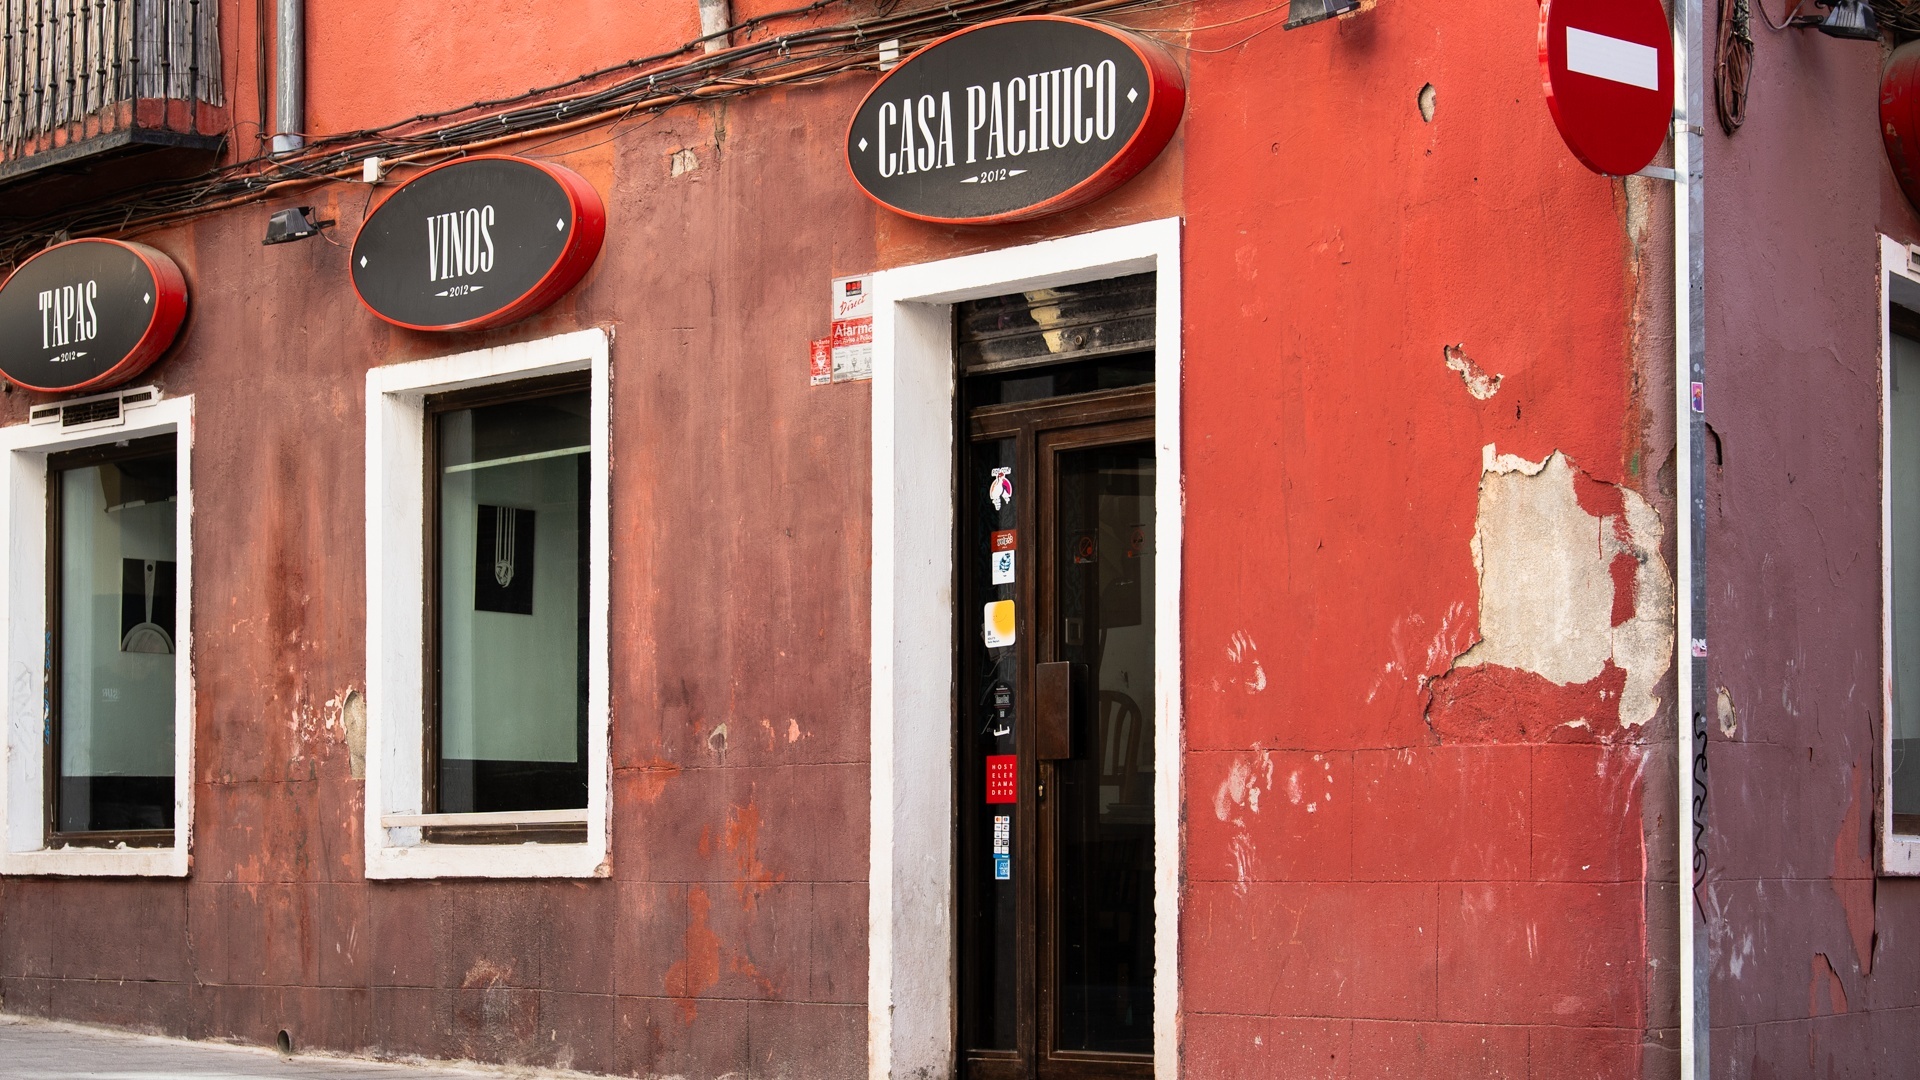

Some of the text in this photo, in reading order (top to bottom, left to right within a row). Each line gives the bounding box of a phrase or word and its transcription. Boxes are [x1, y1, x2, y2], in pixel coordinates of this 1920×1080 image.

[878, 59, 1116, 178] CASA PACHUCO
[980, 168, 1007, 184] 2012
[427, 204, 494, 281] VINOS
[449, 284, 469, 297] 2012
[839, 293, 868, 315] Direct
[39, 280, 97, 349] TAPAS
[834, 322, 873, 338] Alarma
[60, 350, 76, 362] 2012
[991, 763, 1014, 771] HOST
